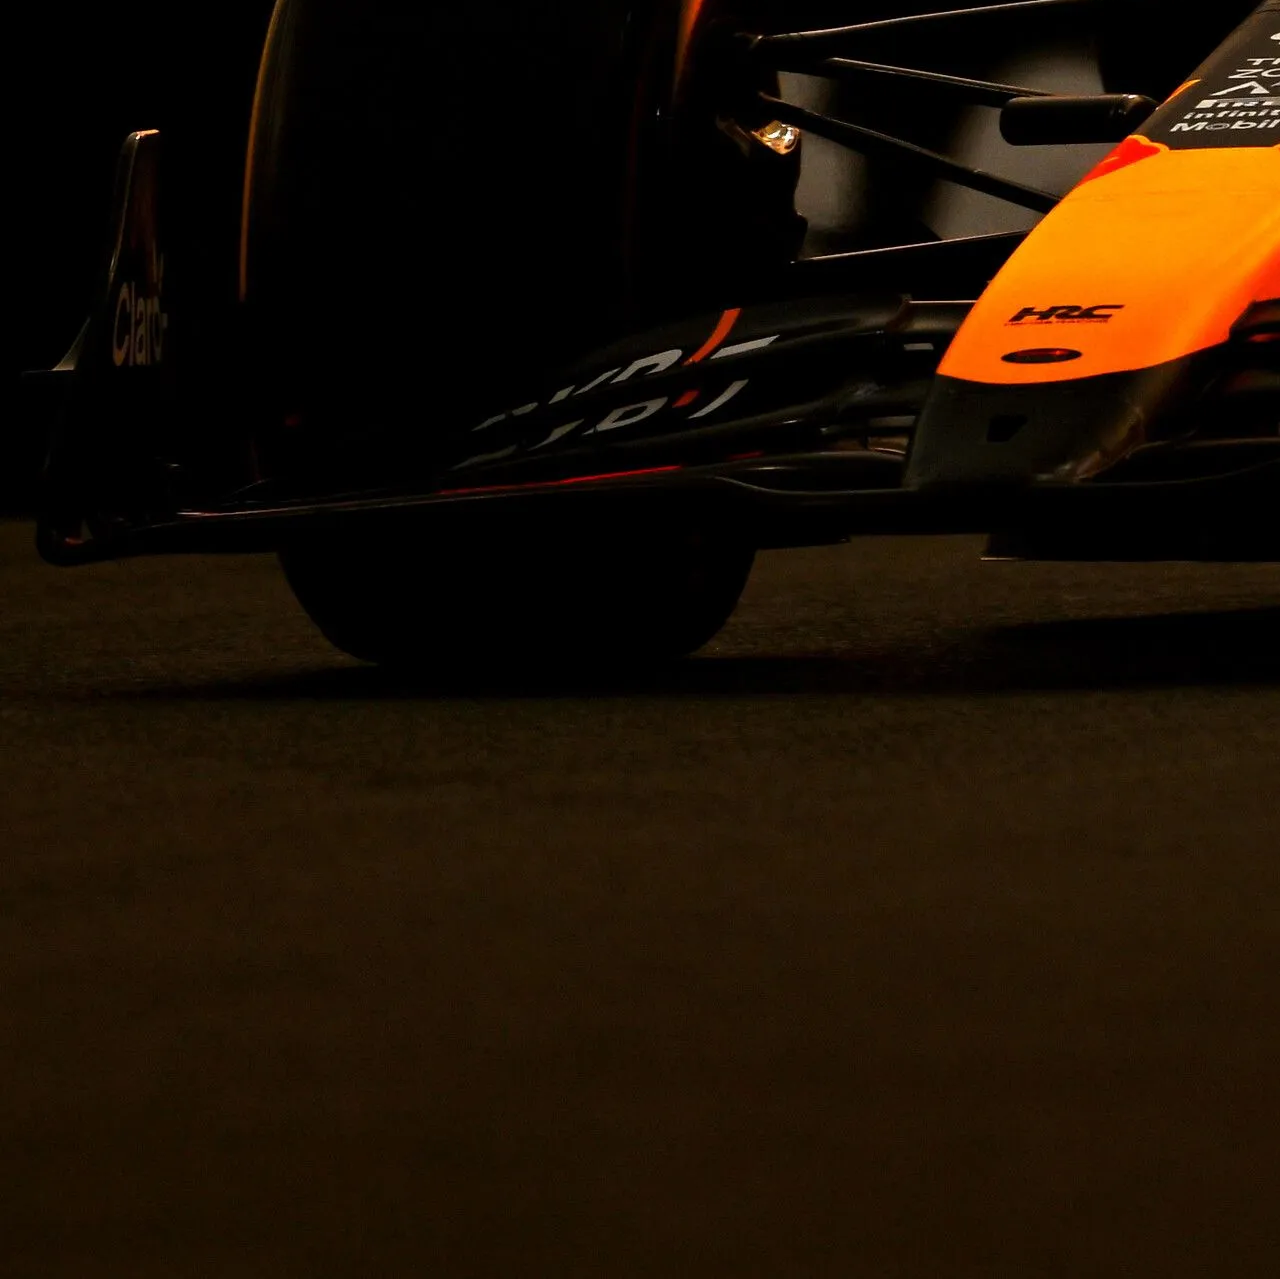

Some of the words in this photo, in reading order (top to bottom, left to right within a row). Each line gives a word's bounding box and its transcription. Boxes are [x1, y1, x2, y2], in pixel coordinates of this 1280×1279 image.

[1169, 119, 1280, 132] Mobil
[1008, 304, 1125, 322] HRC
[112, 280, 164, 368] Claro
